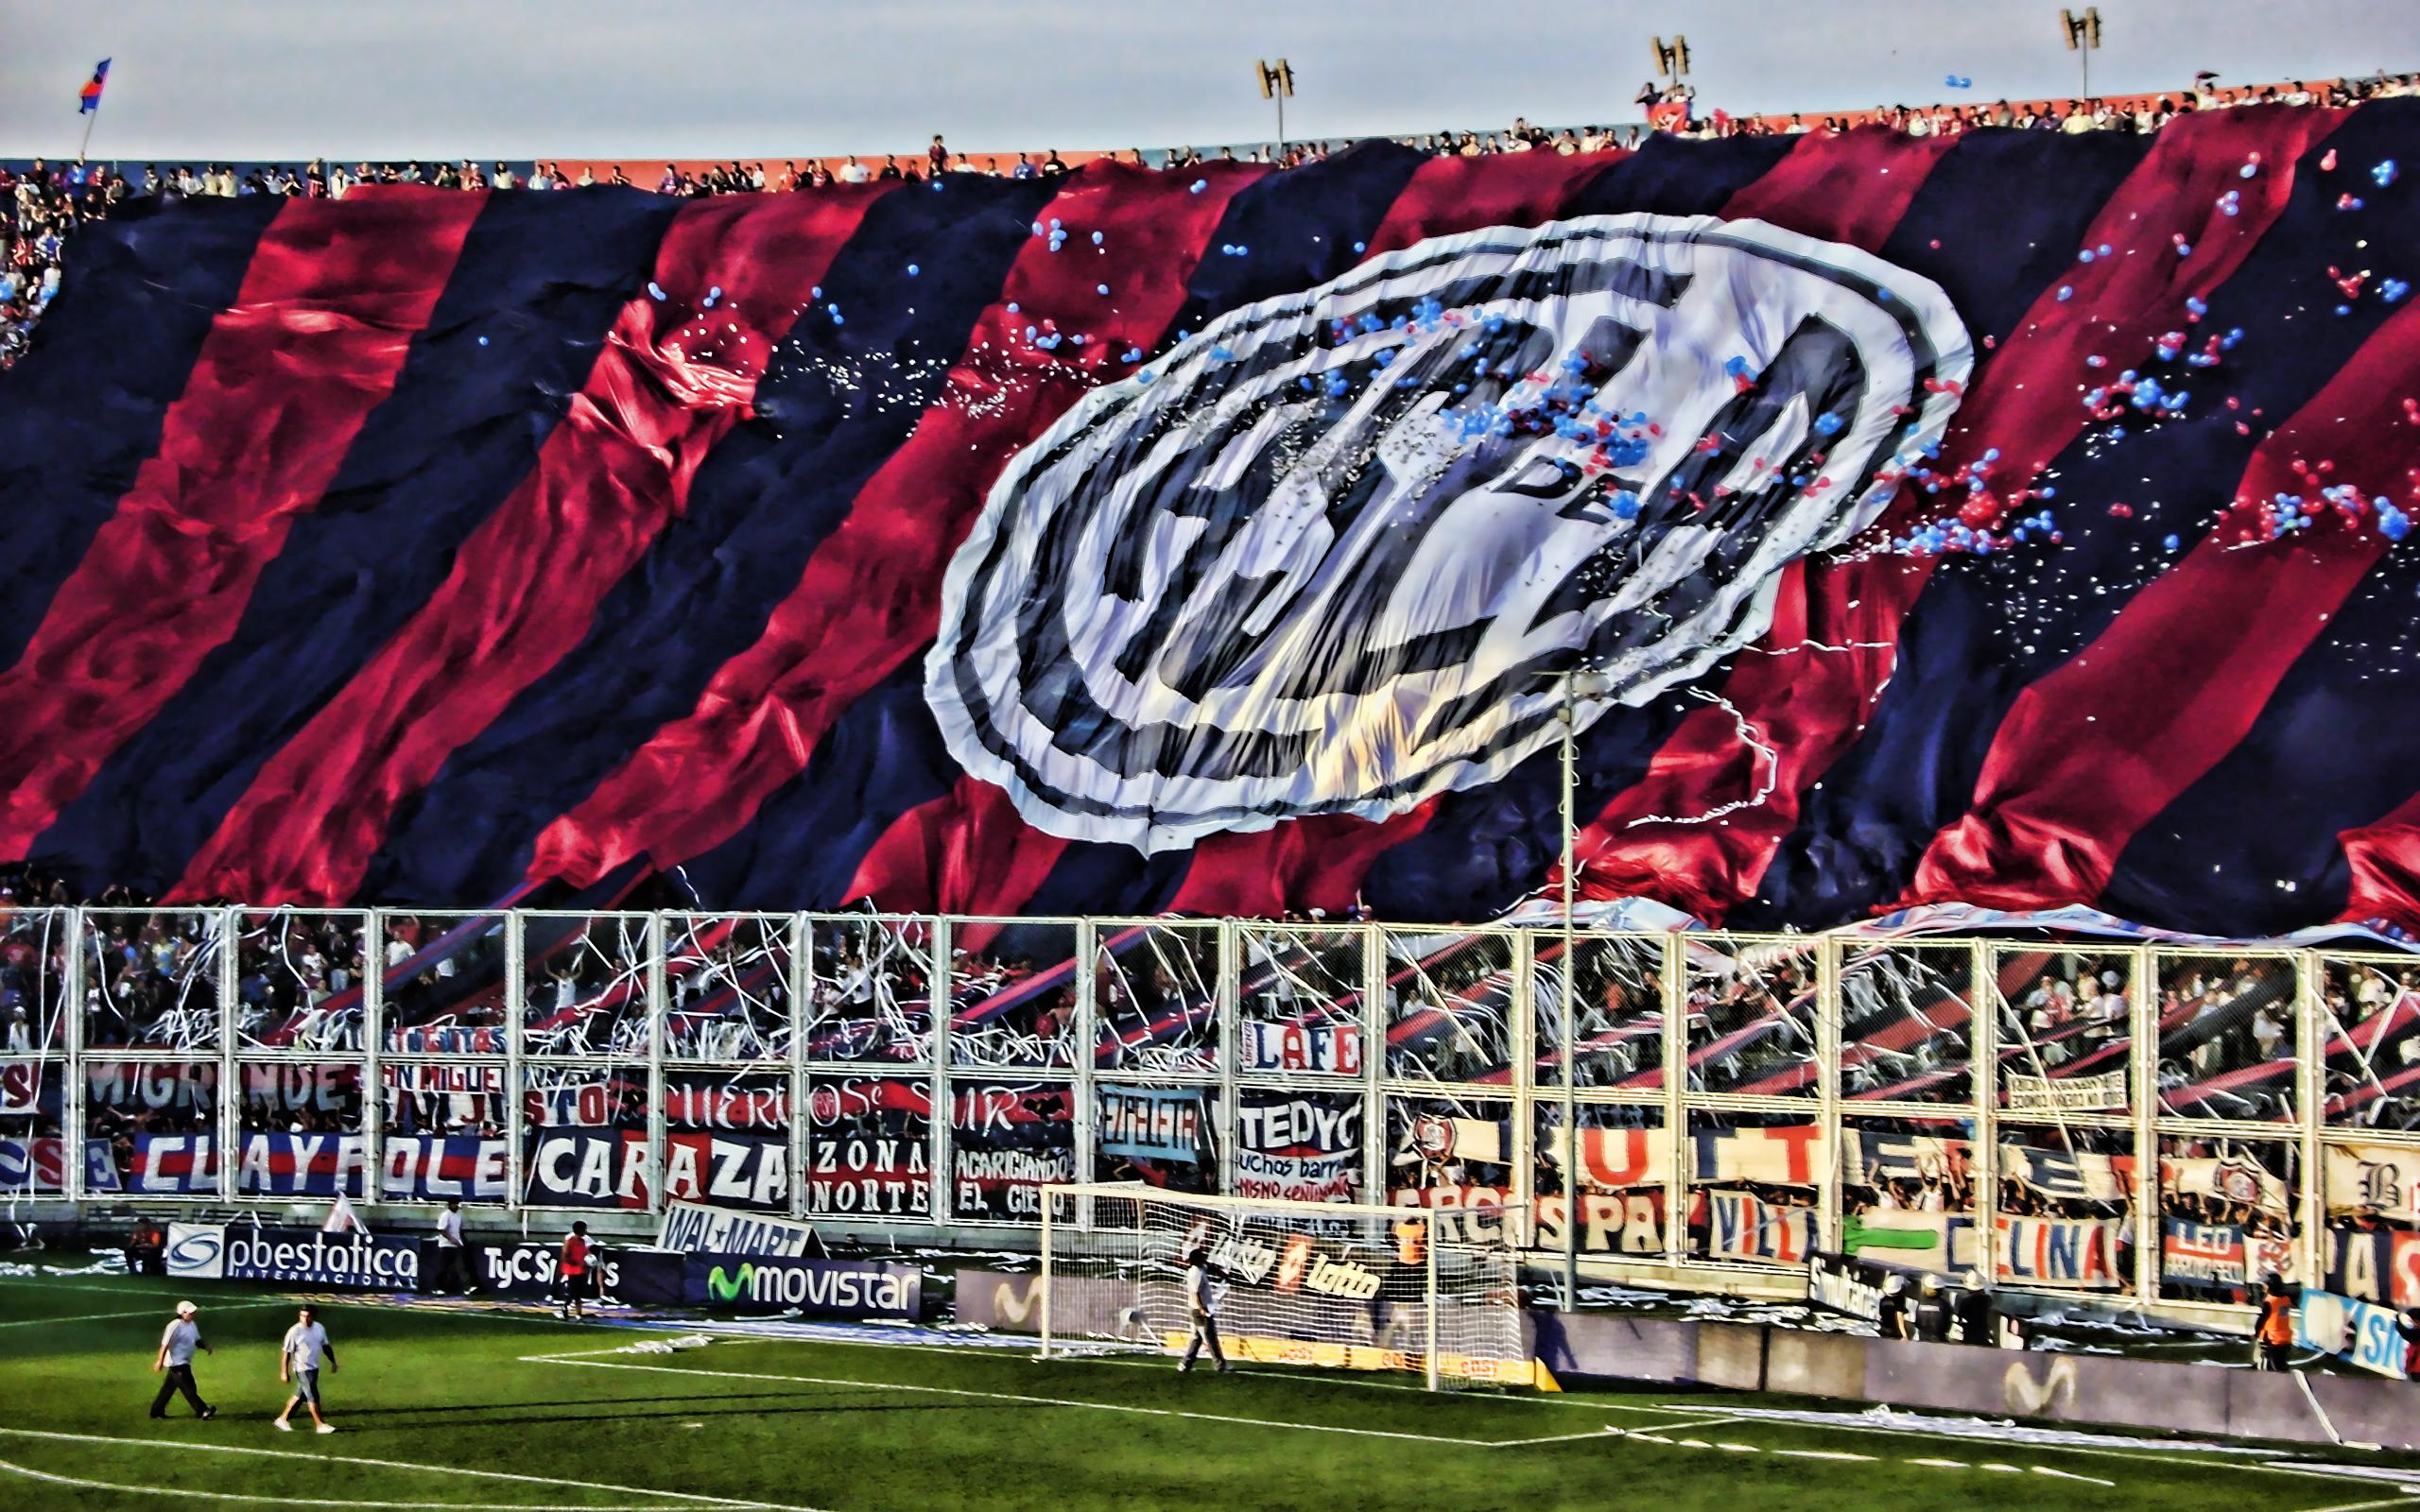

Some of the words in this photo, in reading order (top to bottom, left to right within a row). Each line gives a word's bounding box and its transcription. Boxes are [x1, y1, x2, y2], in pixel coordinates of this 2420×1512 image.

[538, 1136, 788, 1205] CARAZA
[817, 1140, 928, 1176] ZONA
[812, 1179, 929, 1213] NORTE
[958, 1180, 989, 1211] EL
[1007, 1183, 1065, 1216] CIEO
[235, 1268, 418, 1290] INTERNACIONAL
[484, 1246, 531, 1289] TyC
[753, 1265, 916, 1311] movistar
